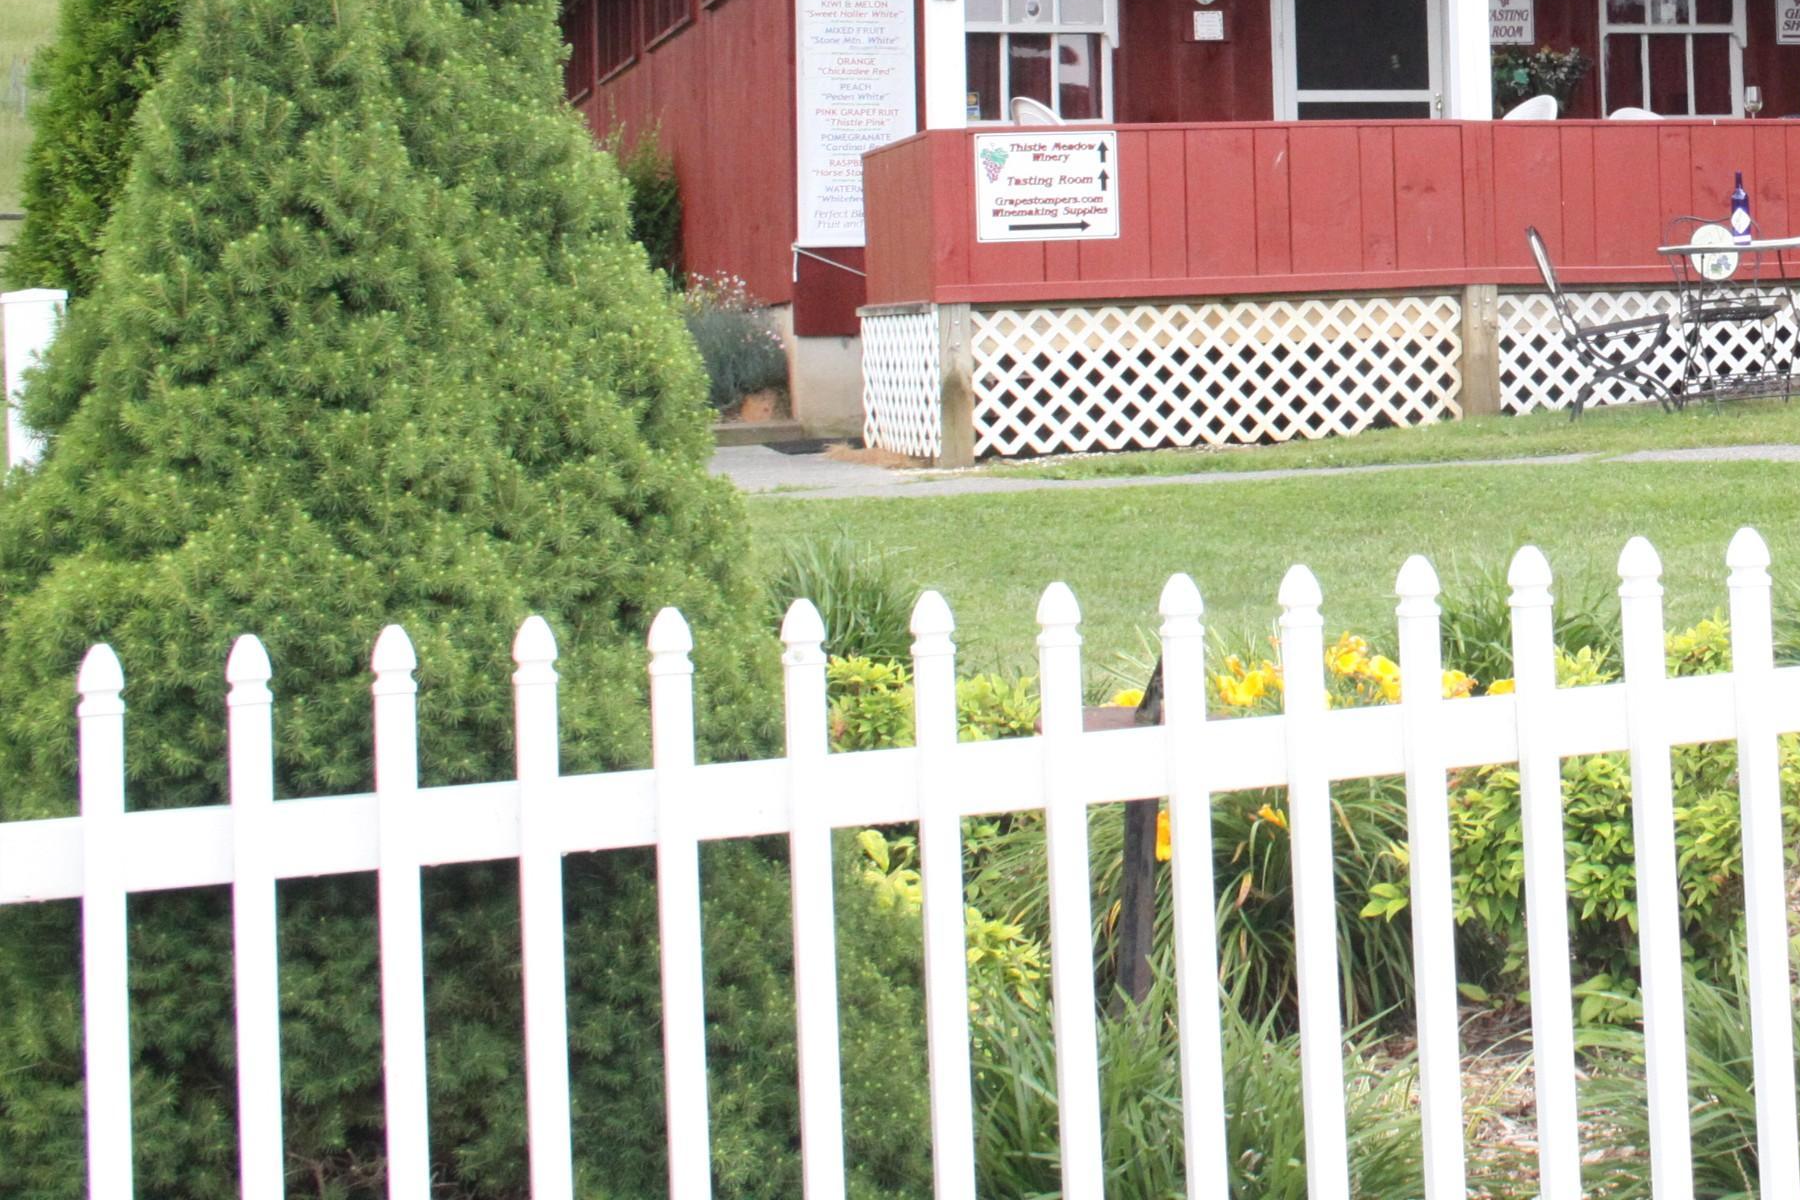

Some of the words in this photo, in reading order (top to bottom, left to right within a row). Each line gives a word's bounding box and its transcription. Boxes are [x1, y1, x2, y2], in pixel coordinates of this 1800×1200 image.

[821, 0, 842, 8] KIWI
[854, 0, 889, 9] MELON
[1489, 9, 1530, 22] ASTING
[825, 26, 855, 34] MIXED
[856, 26, 885, 34] FRUIT
[1491, 25, 1524, 38] ROOM
[836, 56, 876, 65] ORANGE
[840, 83, 872, 91] PEACH
[815, 108, 837, 116] PINK
[840, 108, 899, 116] GRAPEFRUIT
[820, 133, 892, 141] POMEGRANATE
[1009, 142, 1047, 152] Thistle
[1052, 142, 1096, 151] Meadow
[1032, 153, 1071, 163] Winery
[1007, 175, 1053, 188] Tasting
[1058, 175, 1093, 185] Room
[994, 195, 1104, 207] Grapestompers.com
[991, 207, 1059, 218] Winemaking
[1062, 205, 1109, 217] Supplies
